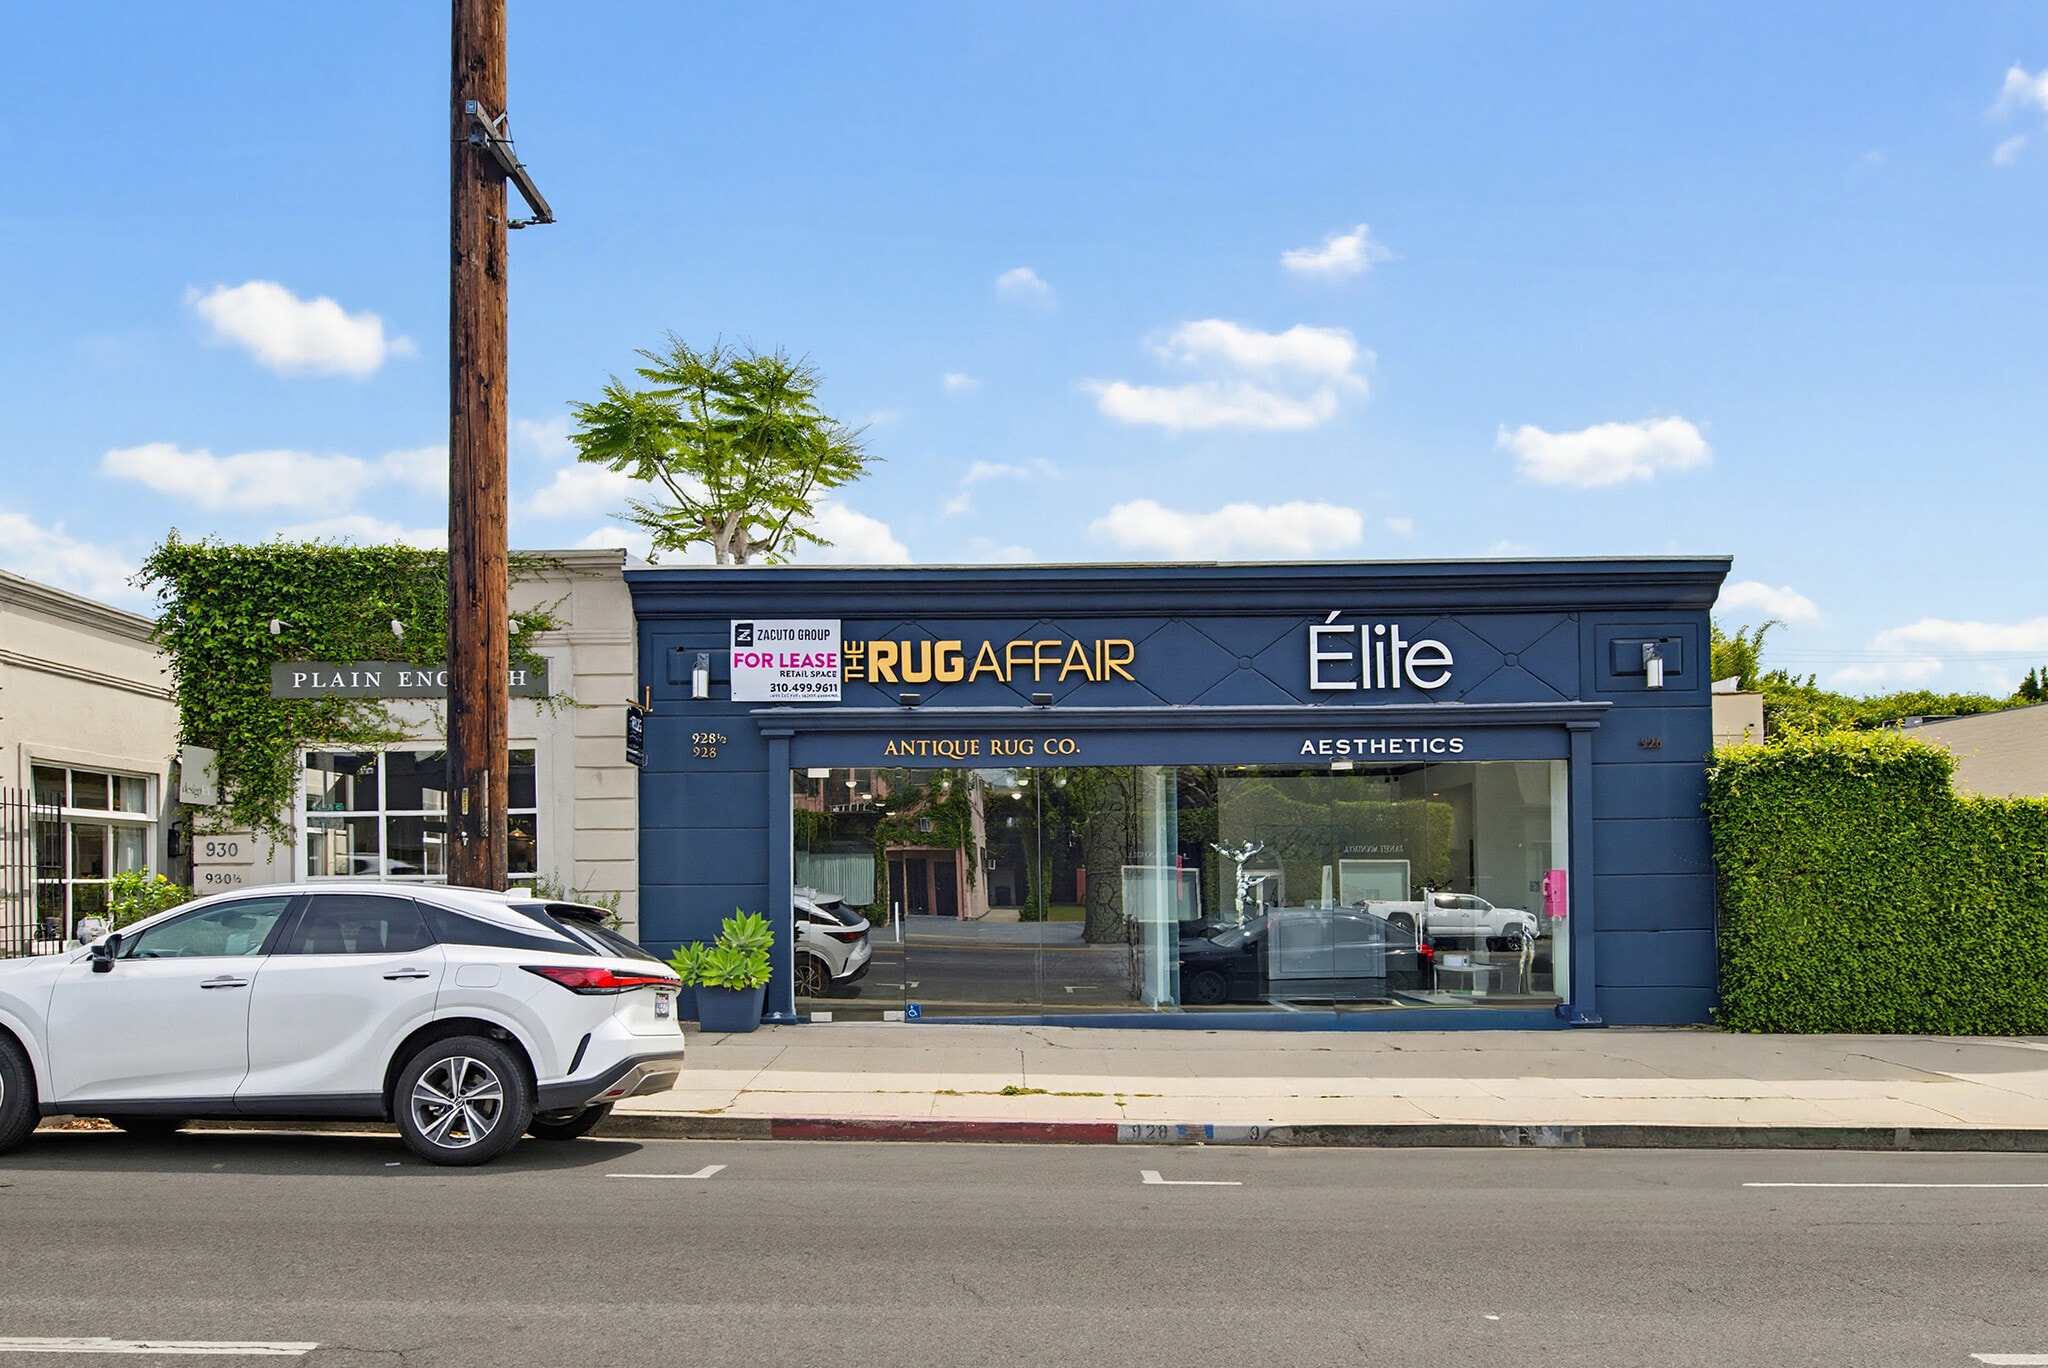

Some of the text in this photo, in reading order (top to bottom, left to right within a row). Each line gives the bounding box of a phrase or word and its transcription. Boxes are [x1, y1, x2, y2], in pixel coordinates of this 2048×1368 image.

[757, 629, 830, 641] ZACUTO GROUP
[1308, 610, 1454, 691] Élite
[734, 653, 837, 668] FOR LEASE
[844, 640, 865, 683] THE
[868, 639, 1136, 683] RUG AFFAIR
[292, 670, 526, 689] PLAIN ENGH
[770, 683, 838, 692] 310.499.9611
[693, 747, 717, 758] 928
[884, 739, 1081, 760] ANTIQUE RUG CO.
[1300, 738, 1464, 755] AESTHETICS
[206, 842, 238, 857] 930
